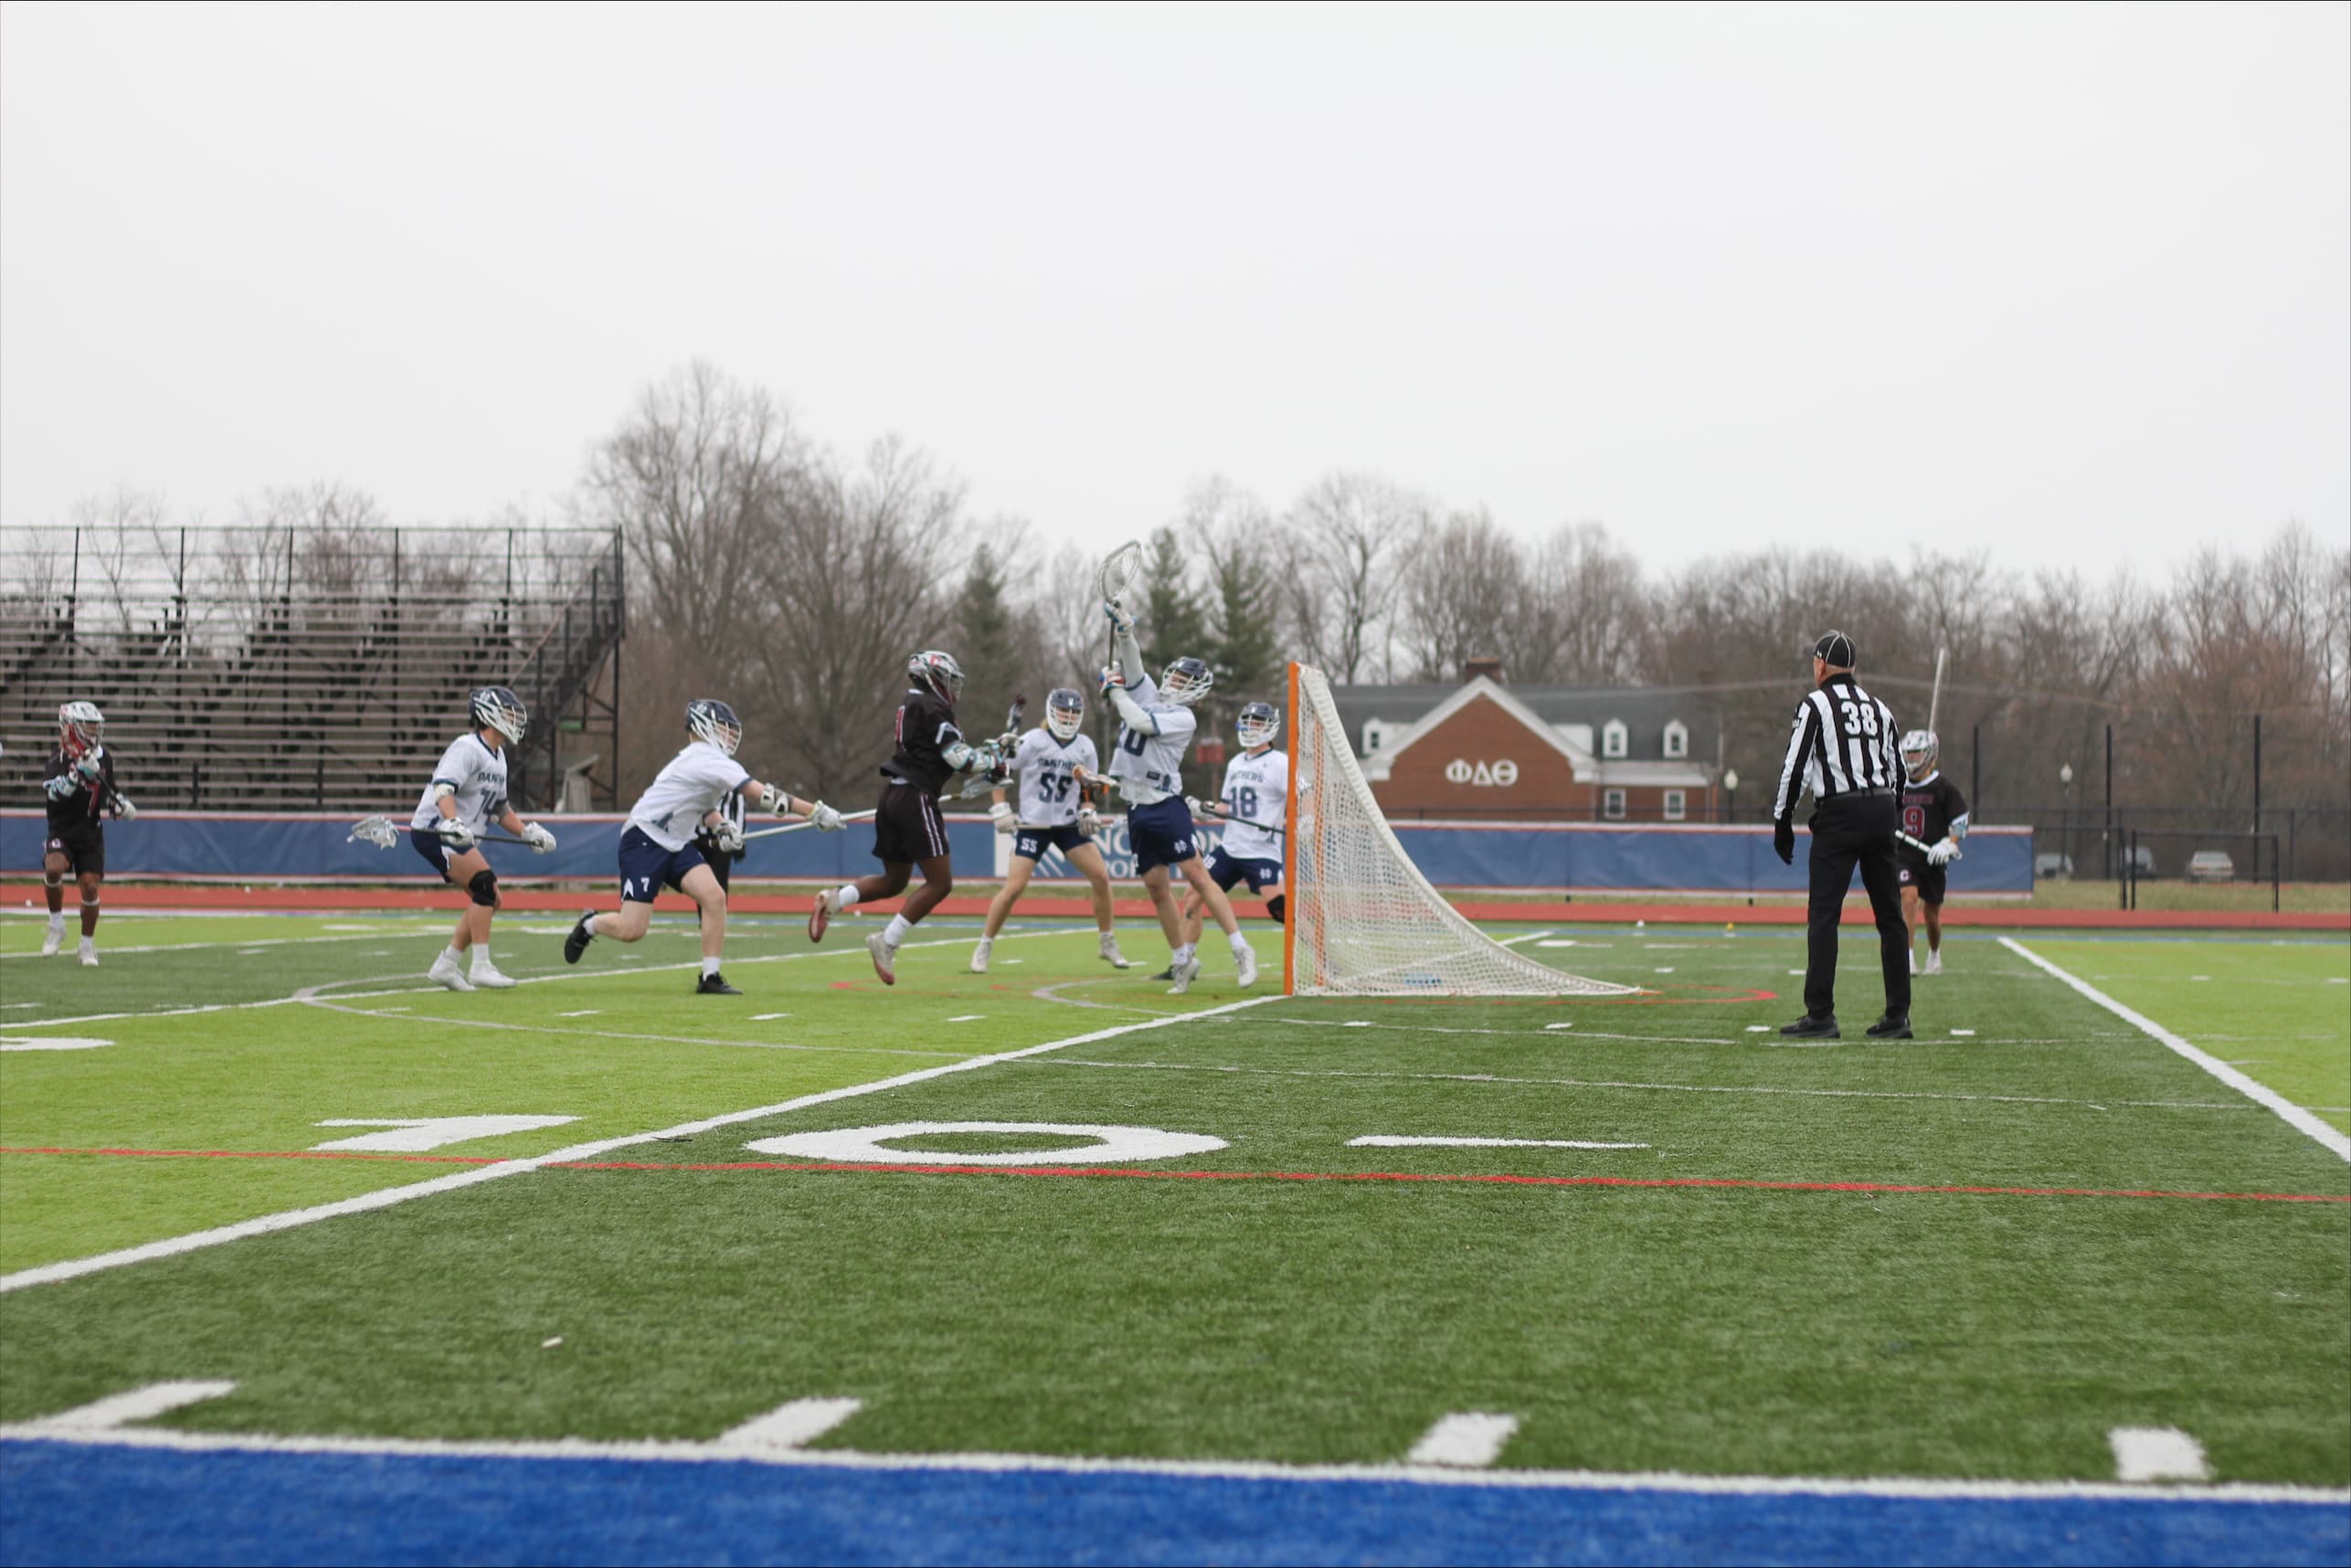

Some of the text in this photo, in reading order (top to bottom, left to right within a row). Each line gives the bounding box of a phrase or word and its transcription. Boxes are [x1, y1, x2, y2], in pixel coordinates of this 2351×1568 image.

[1840, 700, 1879, 737] 38
[1445, 758, 1520, 788] ΦΔΘ
[1902, 804, 1925, 839] 9
[641, 876, 651, 893] 7
